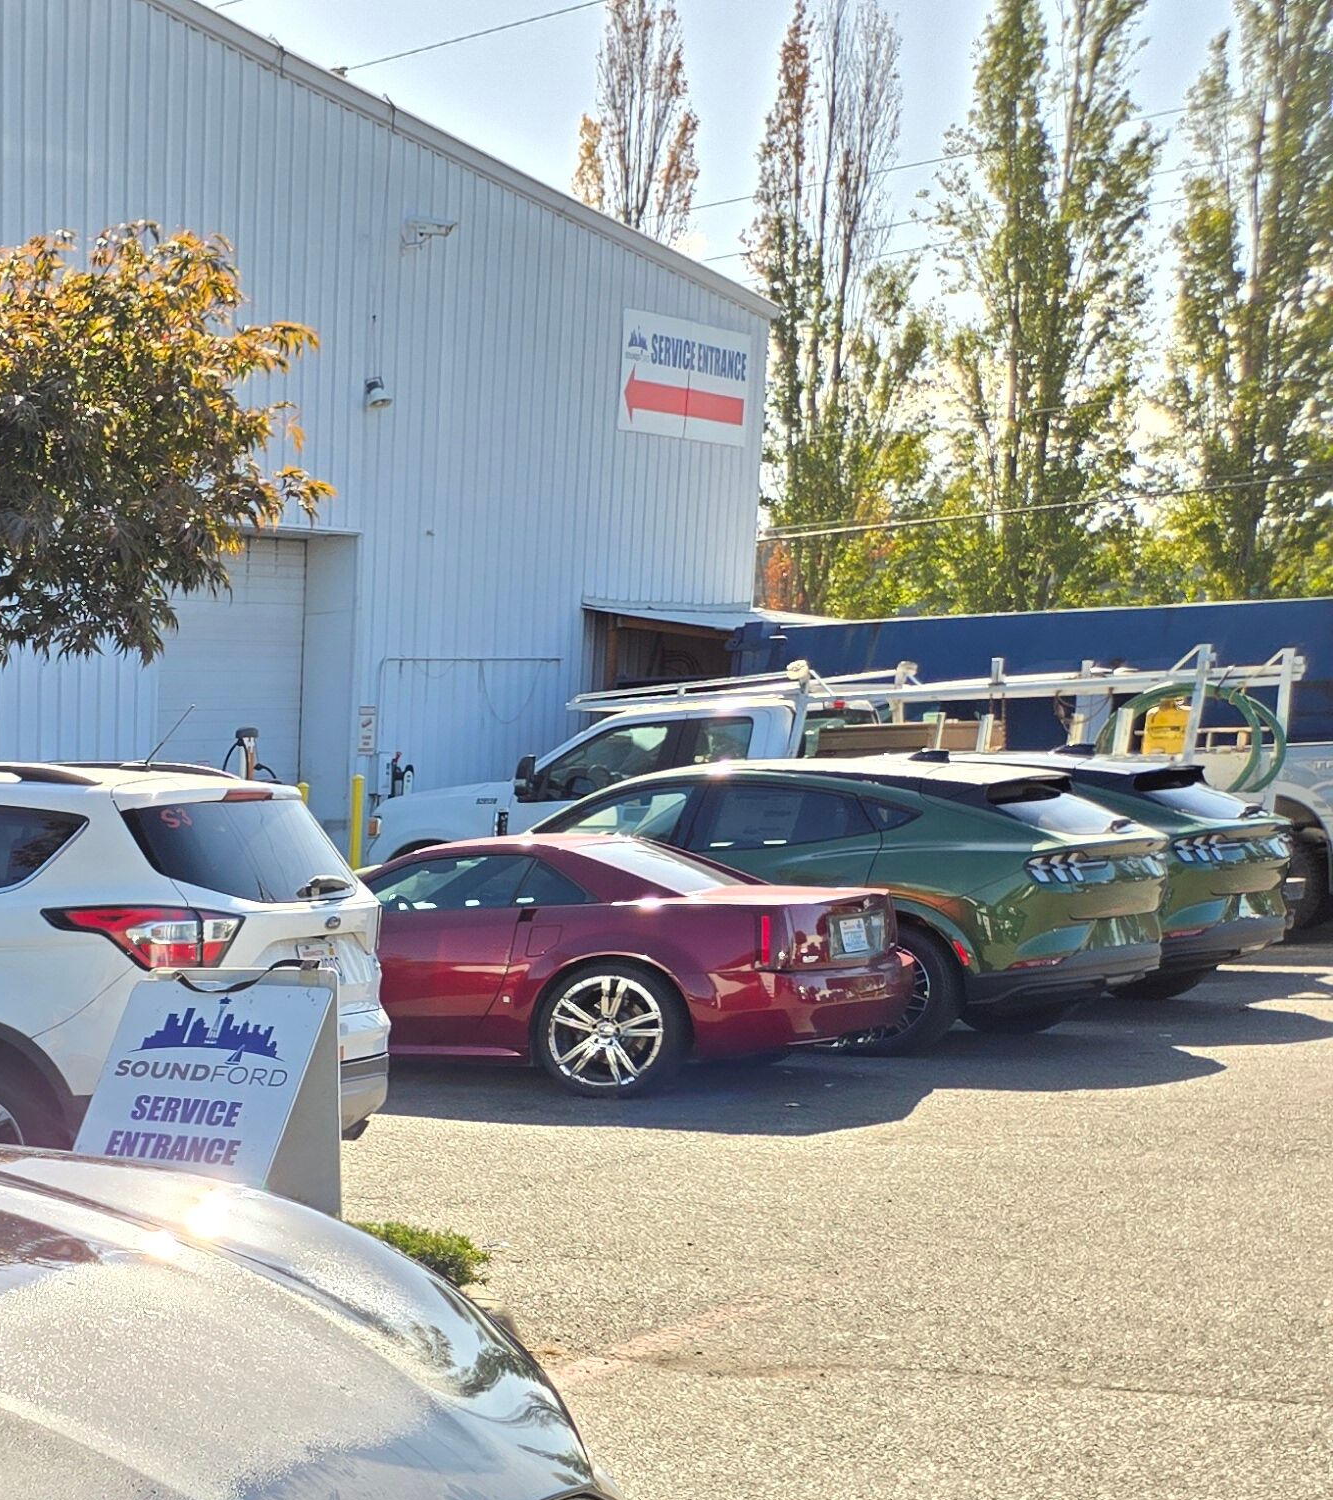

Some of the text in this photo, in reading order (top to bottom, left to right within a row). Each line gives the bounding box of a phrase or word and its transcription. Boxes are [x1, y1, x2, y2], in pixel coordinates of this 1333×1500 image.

[650, 333, 747, 382] SERVICE ENTRANCE
[114, 1059, 288, 1087] SOUNDFORD
[130, 1094, 243, 1128] SERVICE
[104, 1129, 242, 1167] ENTRANCE
